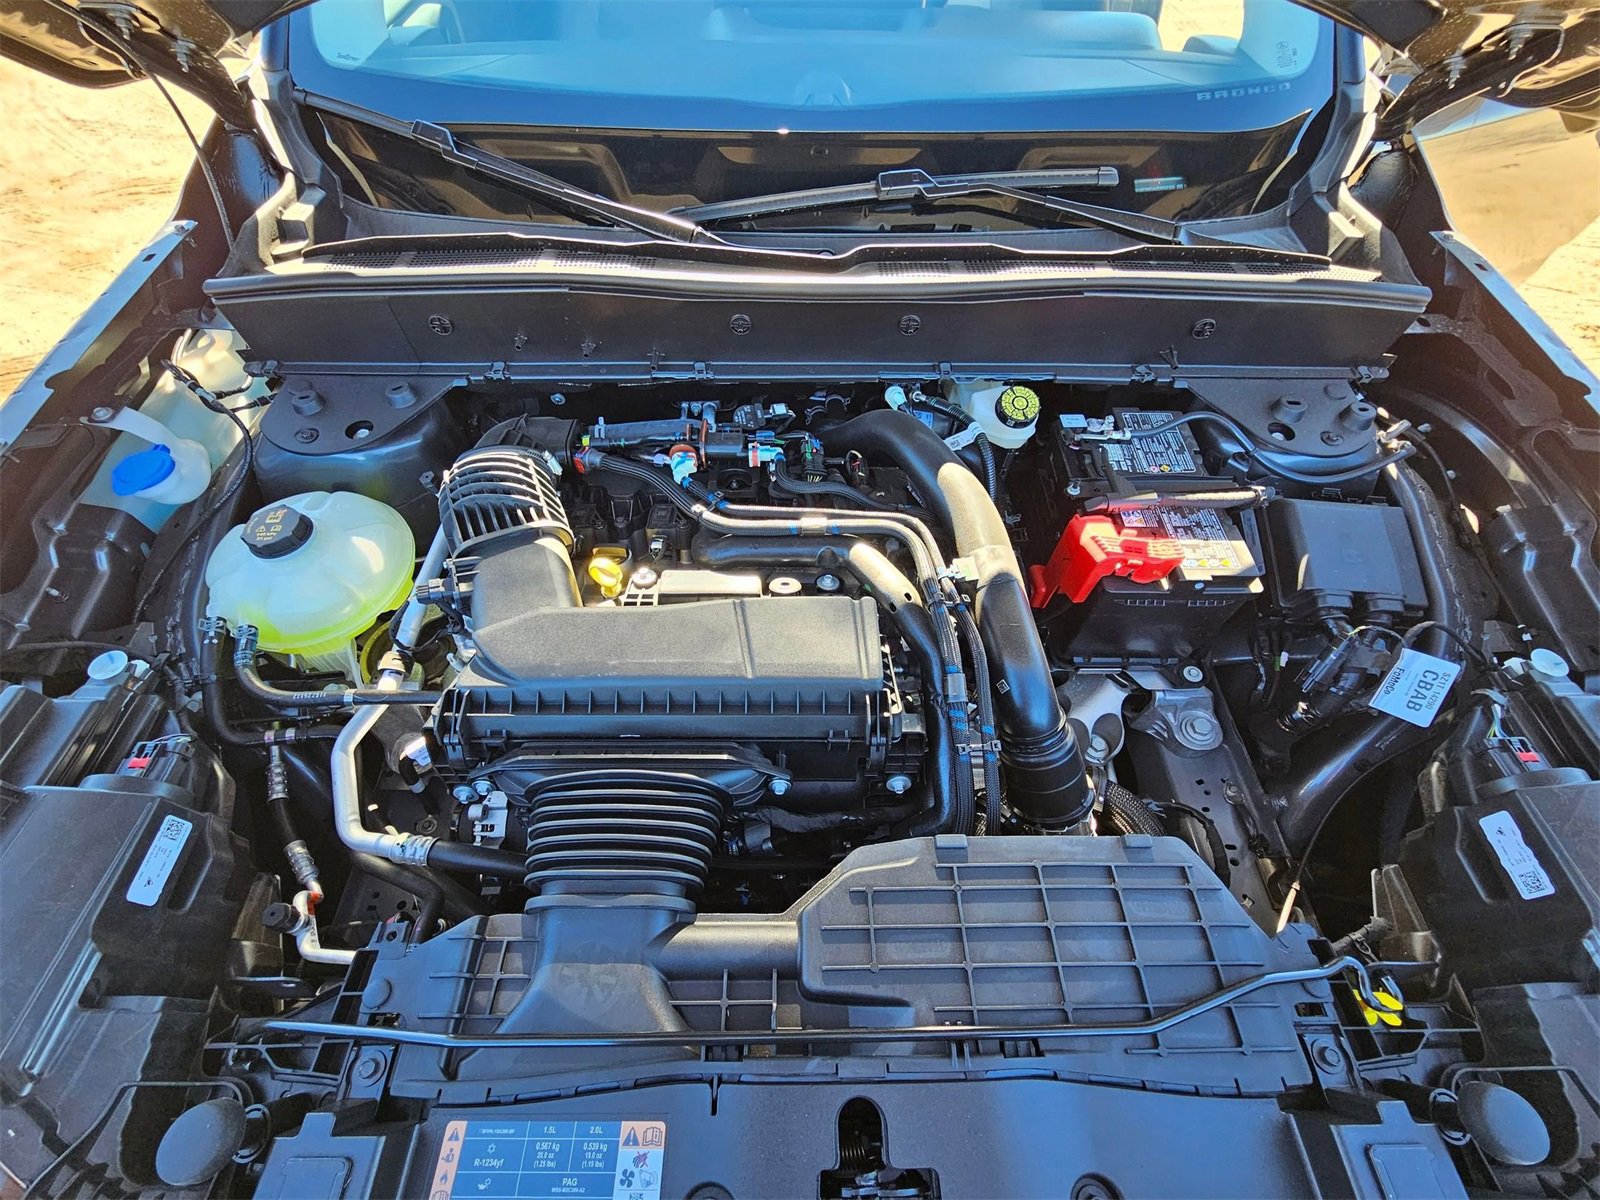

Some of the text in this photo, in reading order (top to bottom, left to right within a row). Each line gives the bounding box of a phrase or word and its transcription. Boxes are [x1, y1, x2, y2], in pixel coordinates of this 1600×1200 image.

[1196, 82, 1291, 101] BRONCO
[1383, 667, 1405, 695] FoMoCo
[1406, 669, 1439, 712] CBAB
[543, 1126, 556, 1134] 1.5L
[589, 1126, 603, 1134] 2.0L
[552, 1142, 560, 1151] kg
[583, 1142, 608, 1152] 0.539 kg
[473, 1158, 505, 1169] R-1234yf
[562, 1178, 578, 1186] PAG
